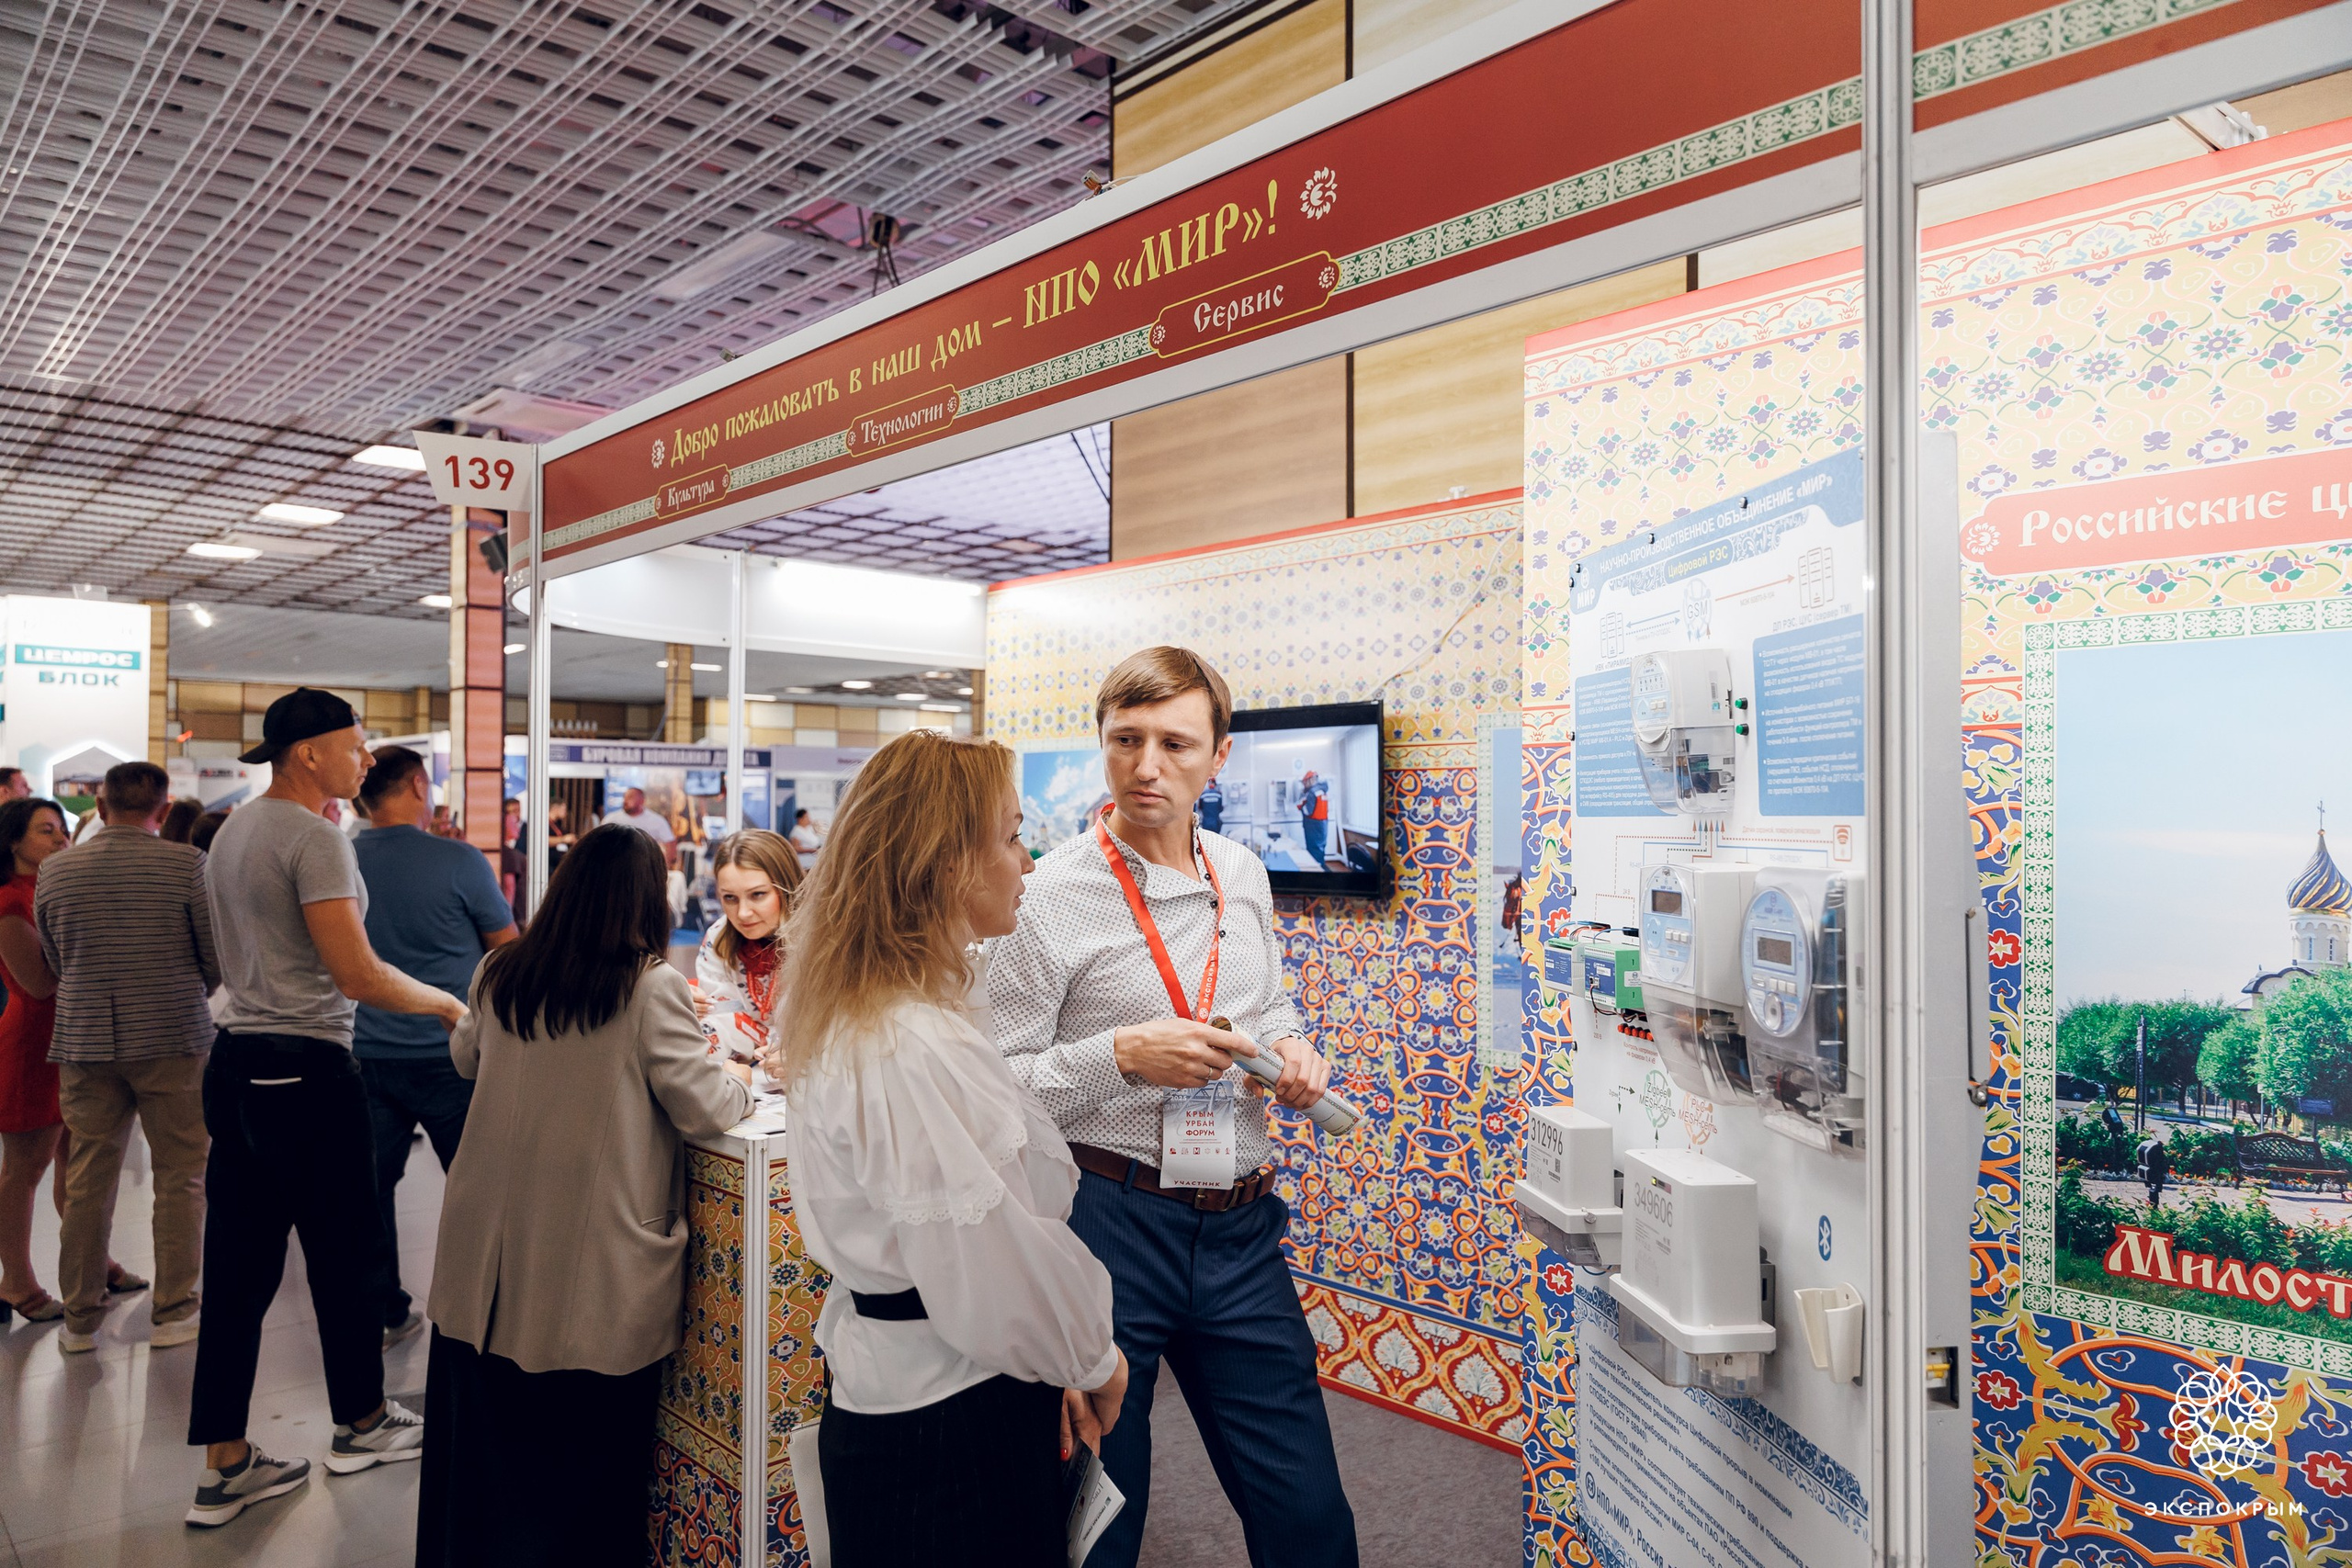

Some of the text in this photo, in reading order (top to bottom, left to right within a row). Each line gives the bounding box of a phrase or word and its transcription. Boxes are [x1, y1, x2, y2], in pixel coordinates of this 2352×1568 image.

[670, 423, 719, 468] Добро
[725, 377, 840, 441] пожаловать
[849, 367, 863, 394] в
[872, 344, 922, 386] наш
[930, 320, 982, 372] дом
[1023, 259, 1101, 329] НПО
[1113, 178, 1278, 291] «МИР»!
[1193, 284, 1284, 333] Сервис
[861, 402, 944, 446] Технологии
[445, 455, 515, 491] 139
[667, 479, 715, 511] Культура
[1600, 473, 1833, 574] НАУЧНО-ПРОИЗВОДСТВЕННОЕ ОБЪЕДИНЕНИЕ «МИР»
[2018, 491, 2289, 547] Российские
[1668, 545, 1729, 579] Цифровой РЭС
[1577, 589, 1596, 609] МИР
[1687, 598, 1709, 620] GSM
[24, 647, 133, 668] ЦЕМРОС
[39, 671, 119, 687] БЛОК
[1646, 1082, 1668, 1100] Zigbee
[1531, 1117, 1564, 1156] 312996
[1634, 1181, 1673, 1227] 349606
[1589, 1384, 1610, 1408] СПОДЭС
[1610, 1372, 1652, 1413] технологическое
[1631, 1377, 1663, 1408] победитель
[1663, 1404, 1689, 1430] конкурса
[1690, 1423, 1722, 1457] Цифровой
[1723, 1452, 1747, 1480] прорыв
[1748, 1474, 1754, 1484] в
[1754, 1479, 1792, 1519] номинации
[1589, 1372, 1607, 1393] Полное
[1607, 1390, 1641, 1423] соответствие
[1641, 1418, 1668, 1446] приборов
[1685, 1456, 1724, 1497] требованиям
[1725, 1489, 1735, 1506] ПП
[1736, 1498, 1747, 1515] РФ
[1759, 1523, 1765, 1534] и
[1765, 1529, 1804, 1567] поддержка
[1589, 1404, 1615, 1435] Продукция
[1615, 1427, 1628, 1445] НПО
[1629, 1441, 1646, 1461] «МИР»
[1646, 1458, 1687, 1498] соответствует
[1687, 1494, 1725, 1536] техническим
[1589, 1438, 1611, 1466] Счетчики
[1611, 1461, 1648, 1502] электрической
[1648, 1497, 1671, 1524] энергии
[1671, 1517, 1685, 1536] МИР
[1593, 1422, 1630, 1460] рекомендуется
[1634, 1459, 1668, 1495] применению
[1668, 1491, 1676, 1503] на
[1676, 1498, 1703, 1529] объектах
[1704, 1522, 1719, 1543] ПАО
[1600, 1463, 1619, 1486] лучших
[1619, 1481, 1640, 1506] товаров
[1596, 1486, 1610, 1515] НПО
